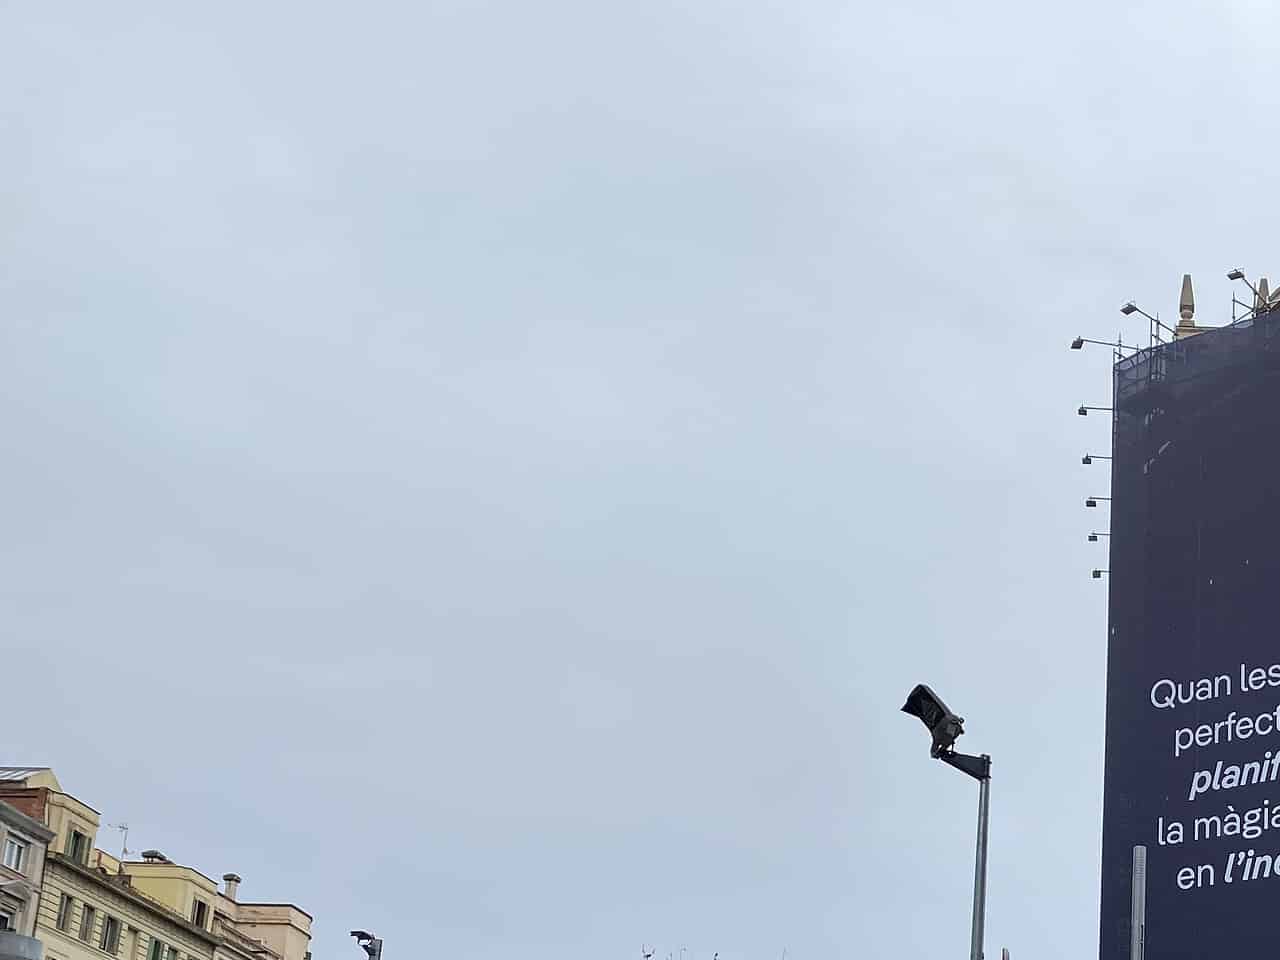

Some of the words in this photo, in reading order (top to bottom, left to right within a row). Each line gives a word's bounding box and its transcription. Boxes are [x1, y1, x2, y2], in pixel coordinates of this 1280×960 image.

[1150, 674, 1231, 709] Quan
[1158, 817, 1183, 845] la
[1176, 863, 1214, 890] en
